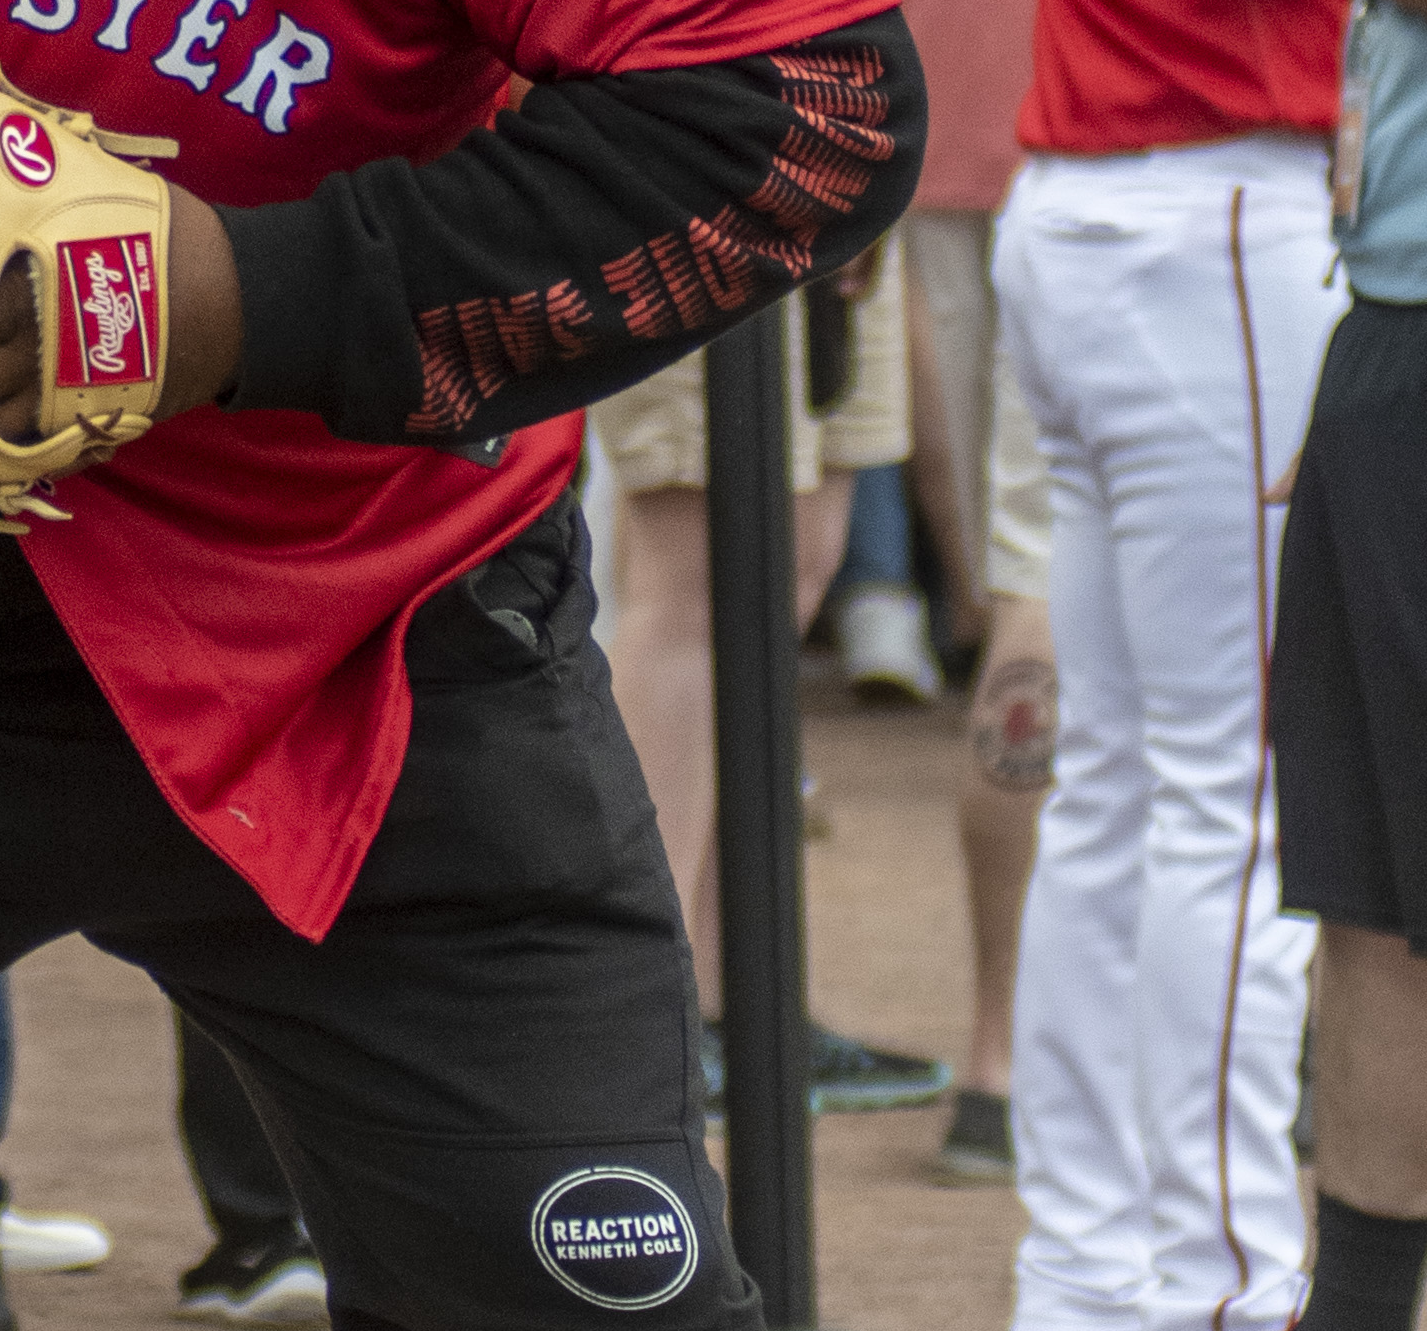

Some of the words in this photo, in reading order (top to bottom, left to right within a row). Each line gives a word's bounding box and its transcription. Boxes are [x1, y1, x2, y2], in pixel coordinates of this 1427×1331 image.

[1, 119, 53, 183] R
[83, 250, 127, 373] Rawlings
[551, 1214, 677, 1243] REACTION
[556, 1242, 637, 1260] KENNETH
[643, 1238, 683, 1256] COLE
